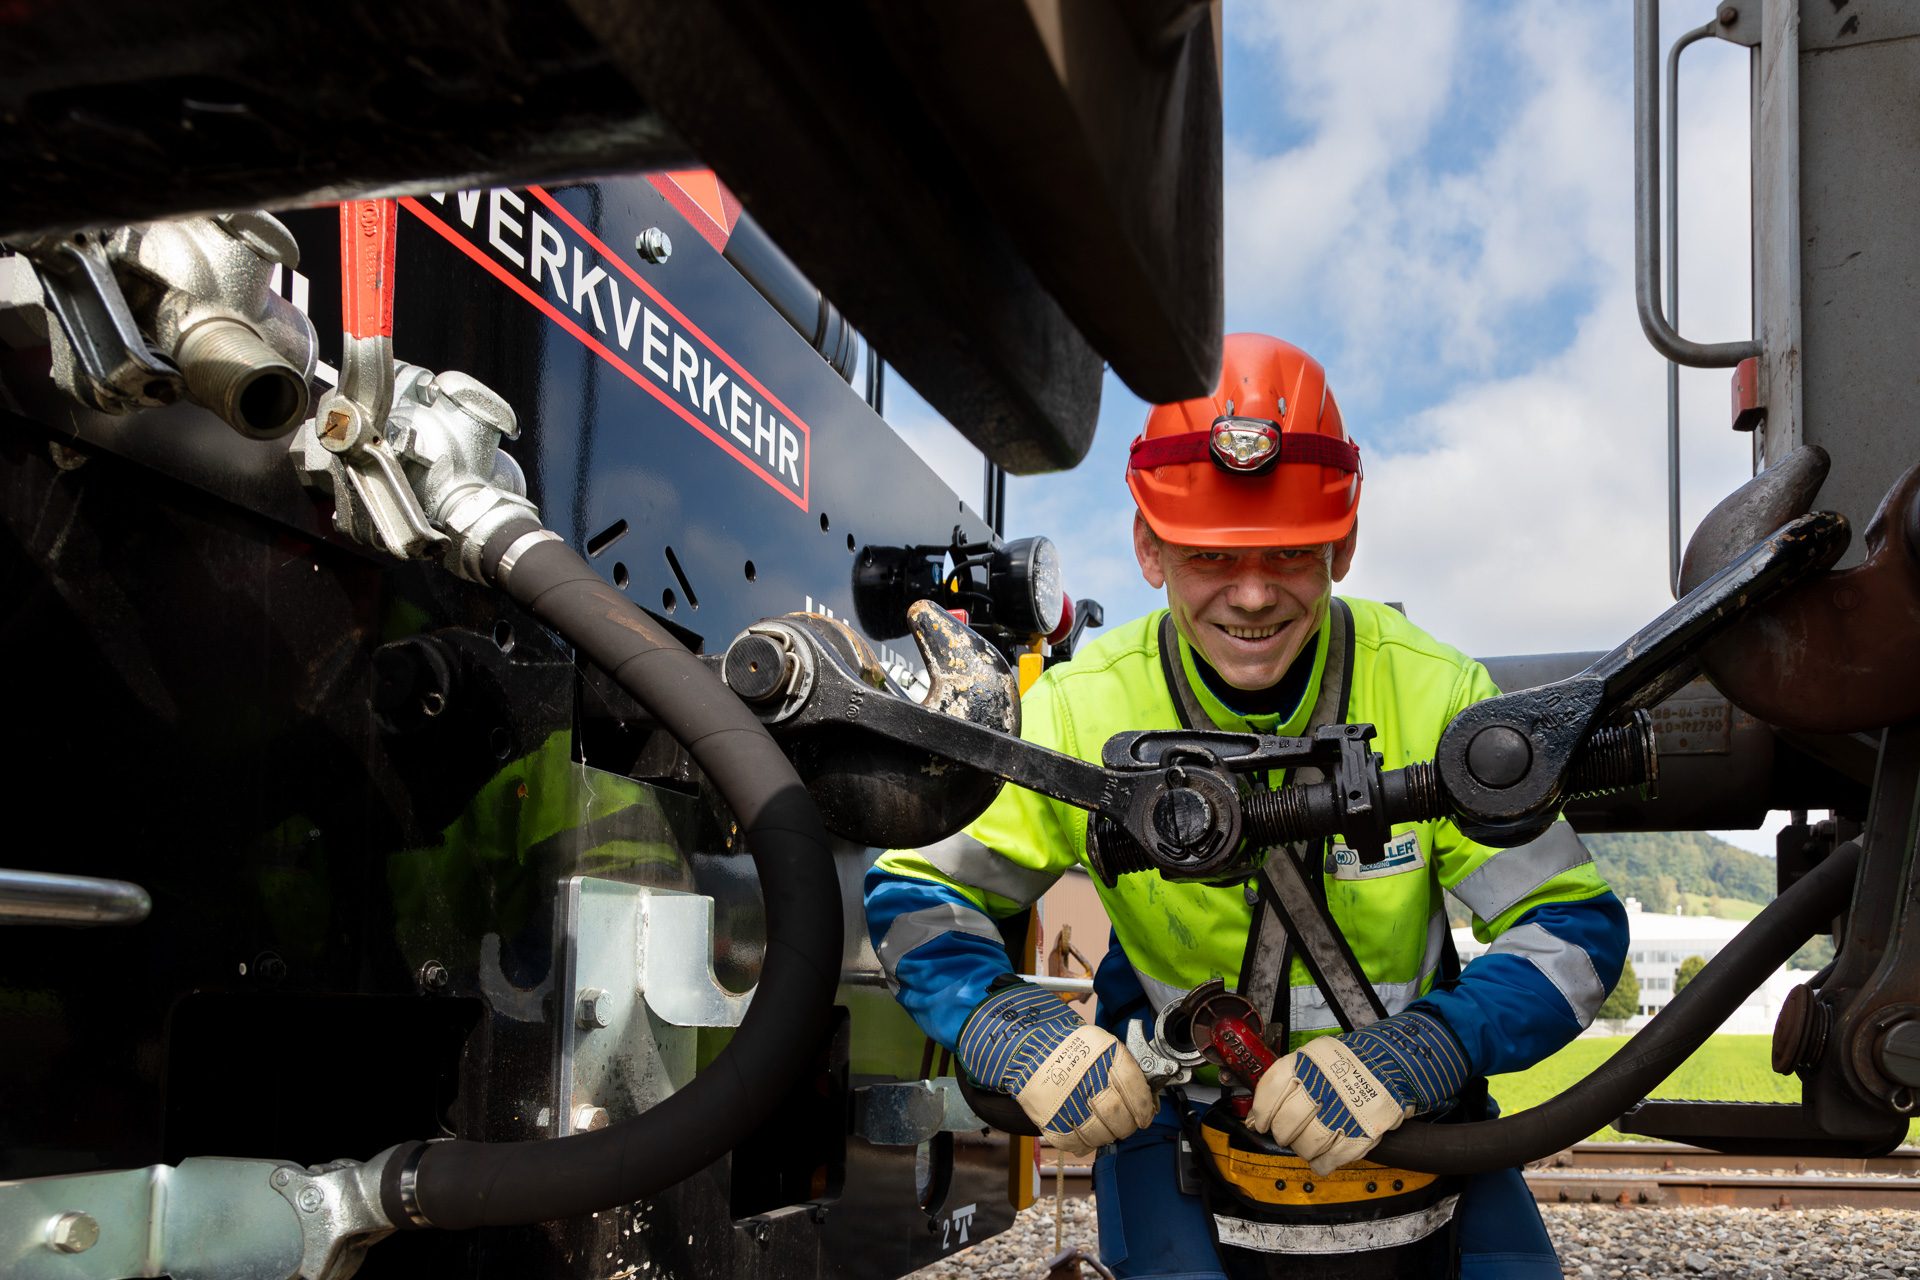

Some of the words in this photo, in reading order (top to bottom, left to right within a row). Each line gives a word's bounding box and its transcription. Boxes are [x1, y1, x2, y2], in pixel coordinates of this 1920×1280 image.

[989, 1000, 1015, 1019] EXTRA
[989, 1005, 1041, 1045] RESISTA
[1055, 1036, 1080, 1064] RESISTA
[1353, 1069, 1378, 1099] RESISTA
[942, 1218, 950, 1251] 2
